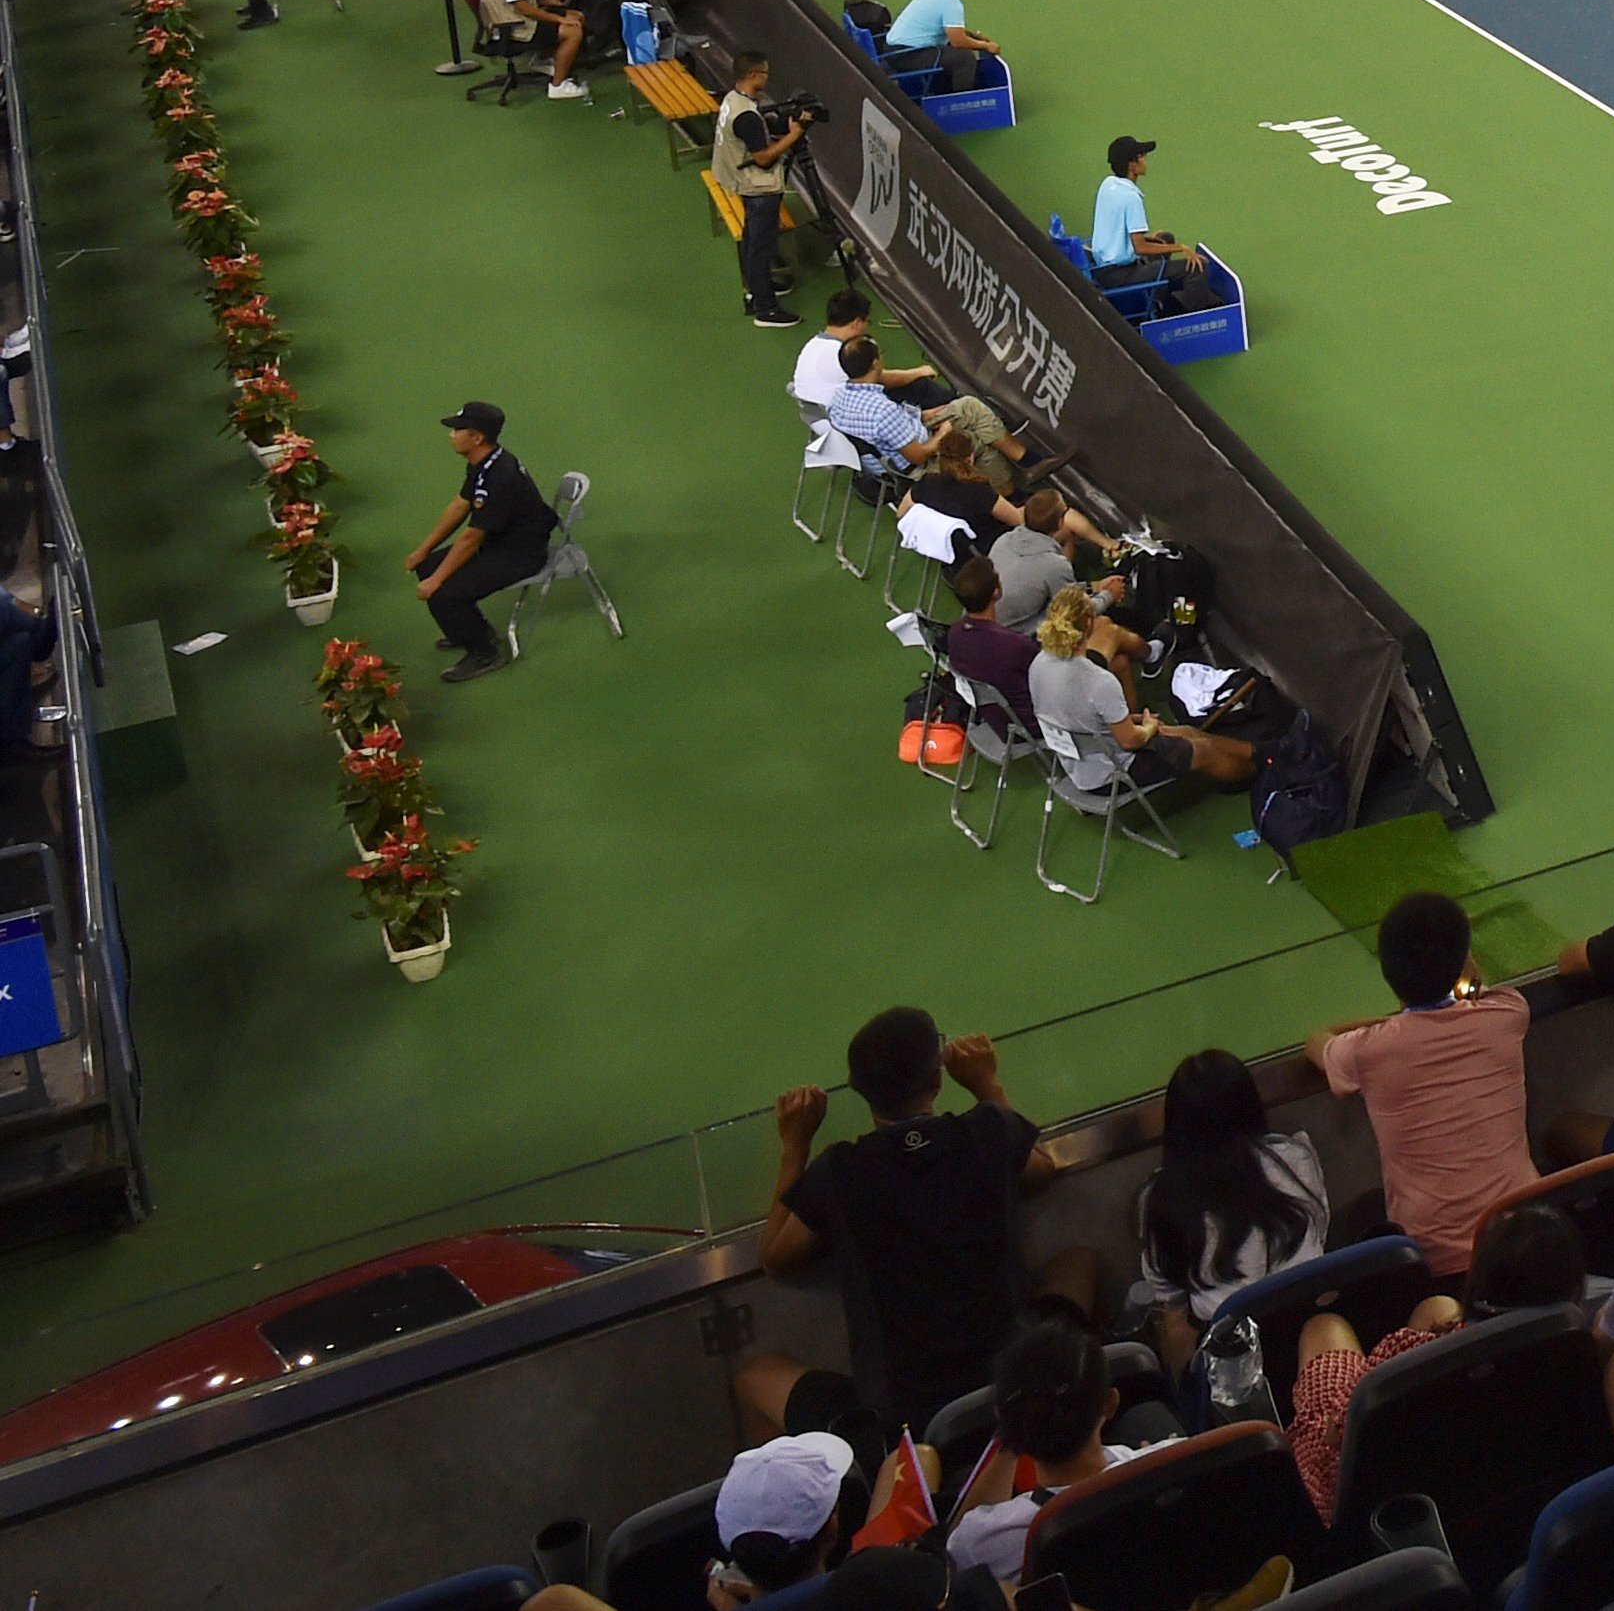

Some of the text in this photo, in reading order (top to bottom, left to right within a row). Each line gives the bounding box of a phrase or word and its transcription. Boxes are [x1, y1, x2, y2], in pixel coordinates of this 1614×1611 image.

[1270, 116, 1452, 216] DecoTurf
[907, 179, 1078, 428] 武汉网球公开赛
